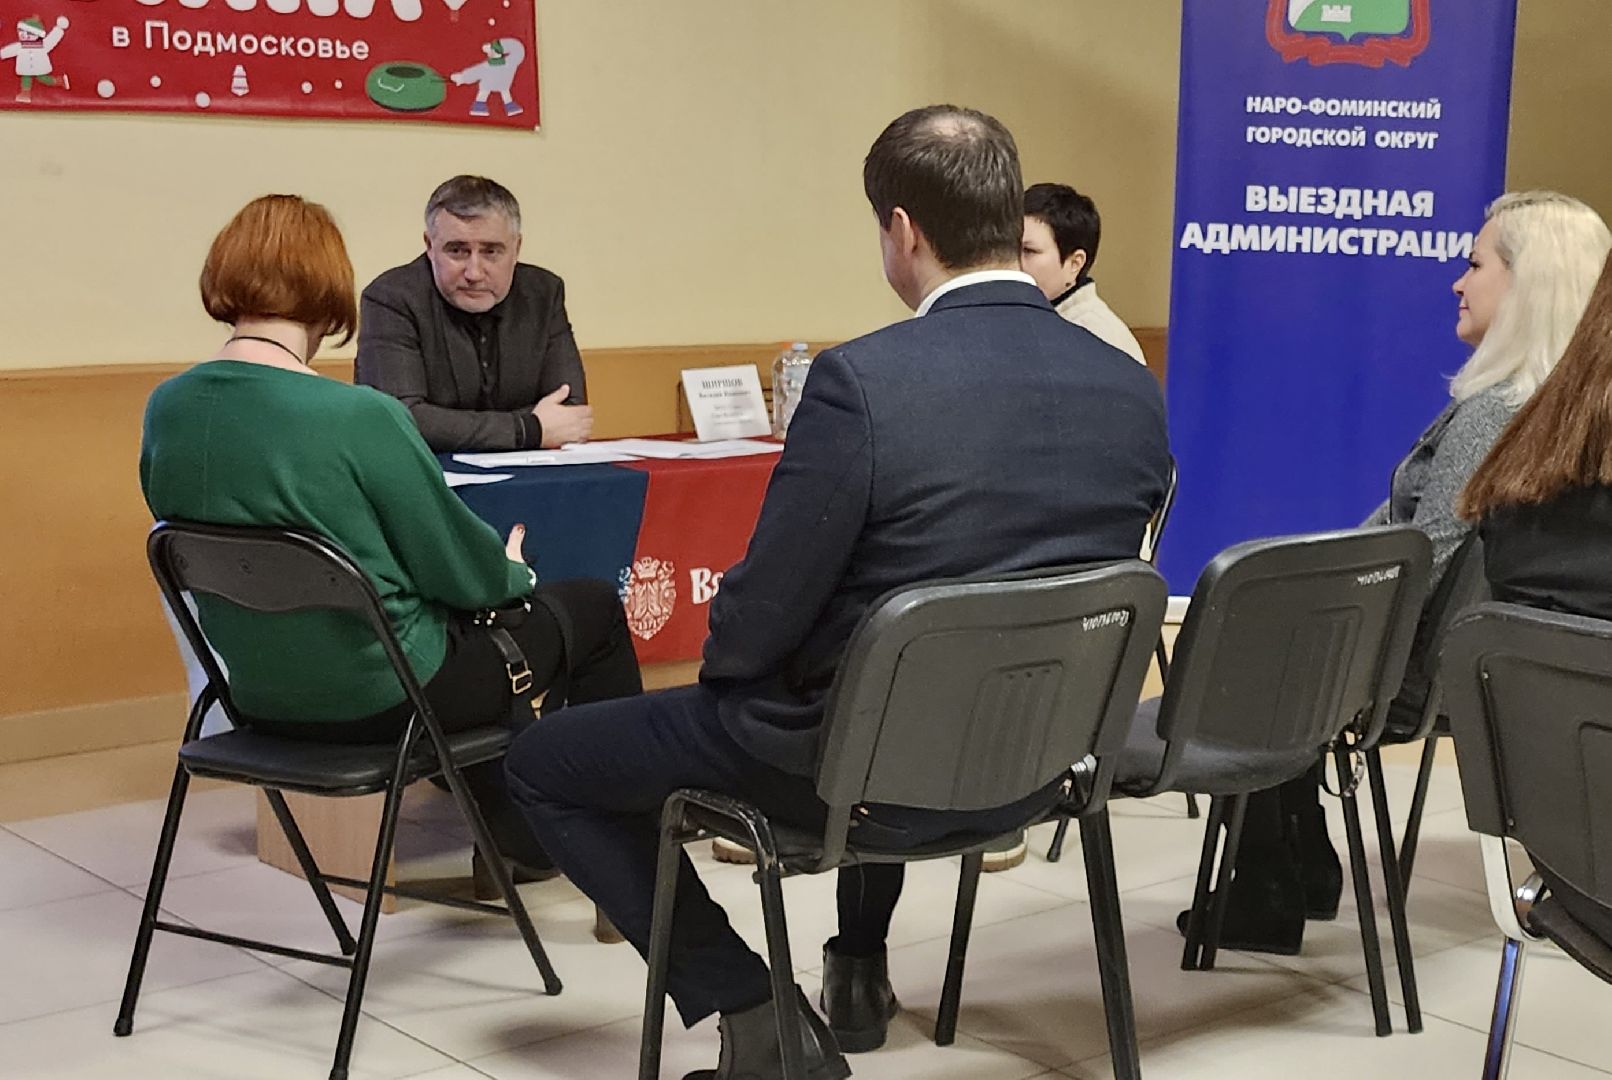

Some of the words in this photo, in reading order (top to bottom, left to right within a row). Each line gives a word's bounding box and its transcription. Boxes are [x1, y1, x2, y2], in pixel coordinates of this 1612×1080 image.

[112, 26, 131, 47] в
[144, 21, 370, 61] Подмосковье
[1246, 96, 1441, 119] НАРО-ФОМИНСКИЙ
[1246, 126, 1366, 148] ГОРОДСКОЙ
[1374, 130, 1439, 149] ОКРУГ
[1245, 185, 1434, 220] ВЫЕЗДНАЯ
[1180, 222, 1477, 263] АДМИНИСТРАЦИ
